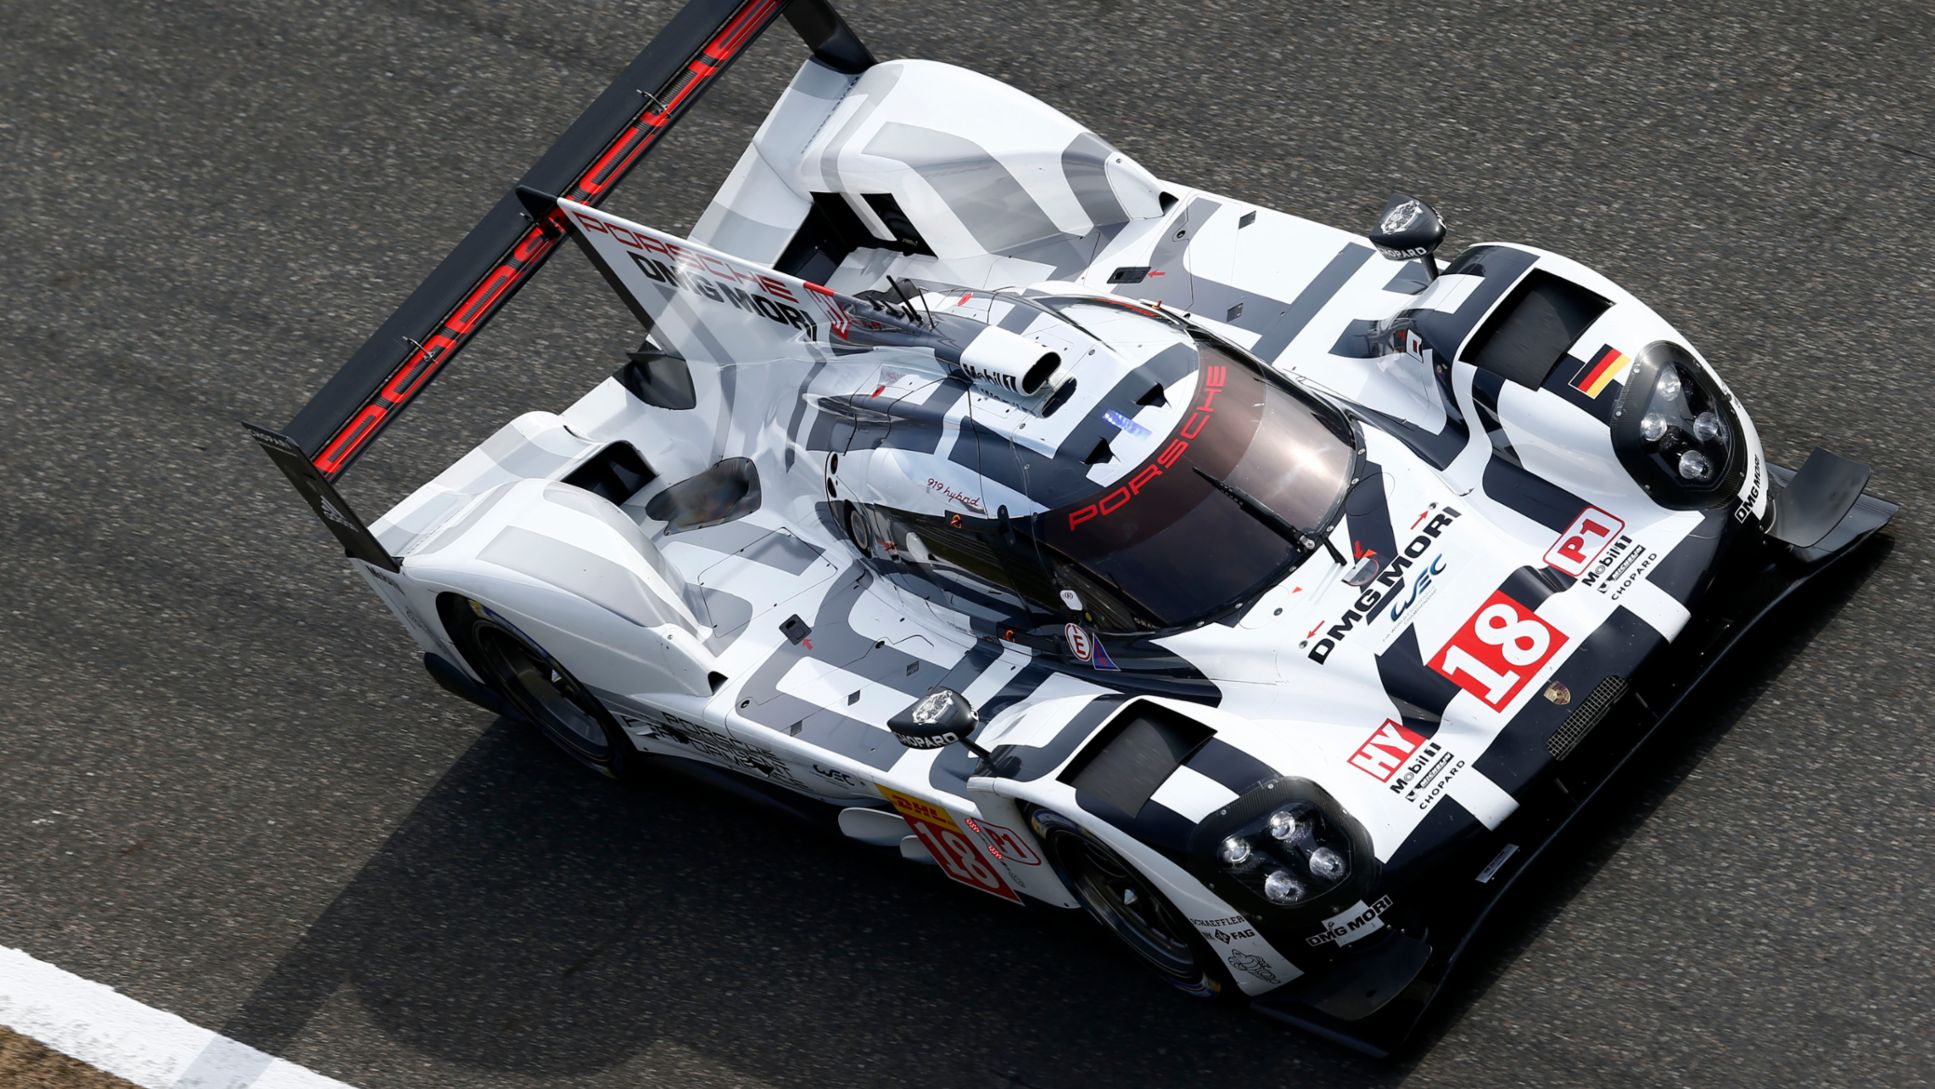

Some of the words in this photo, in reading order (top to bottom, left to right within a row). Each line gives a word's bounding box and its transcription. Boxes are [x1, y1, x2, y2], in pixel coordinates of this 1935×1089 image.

[572, 211, 799, 303] PORSCHE
[627, 250, 724, 303] DMG
[717, 283, 818, 342] MORI
[1068, 366, 1227, 531] PORSCHE
[927, 478, 944, 491] 919
[1736, 486, 1759, 519] DMG
[1558, 518, 1610, 564] P1
[1611, 546, 1645, 581] MICHELIN
[1308, 588, 1381, 665] DMG
[1377, 506, 1462, 587] MORI
[1391, 554, 1446, 622] WEC
[1581, 548, 1621, 587] Mobil
[1611, 553, 1657, 600] CHOPARD
[1441, 603, 1550, 704] 18
[1350, 721, 1416, 781] HY
[1390, 755, 1429, 794] Mobil
[892, 794, 938, 818] DHL
[1419, 760, 1465, 809] CHOPARD
[913, 821, 1000, 888] 18
[1231, 928, 1255, 940] FAG
[1308, 926, 1347, 946] DMG
[1347, 897, 1392, 931] MORI
